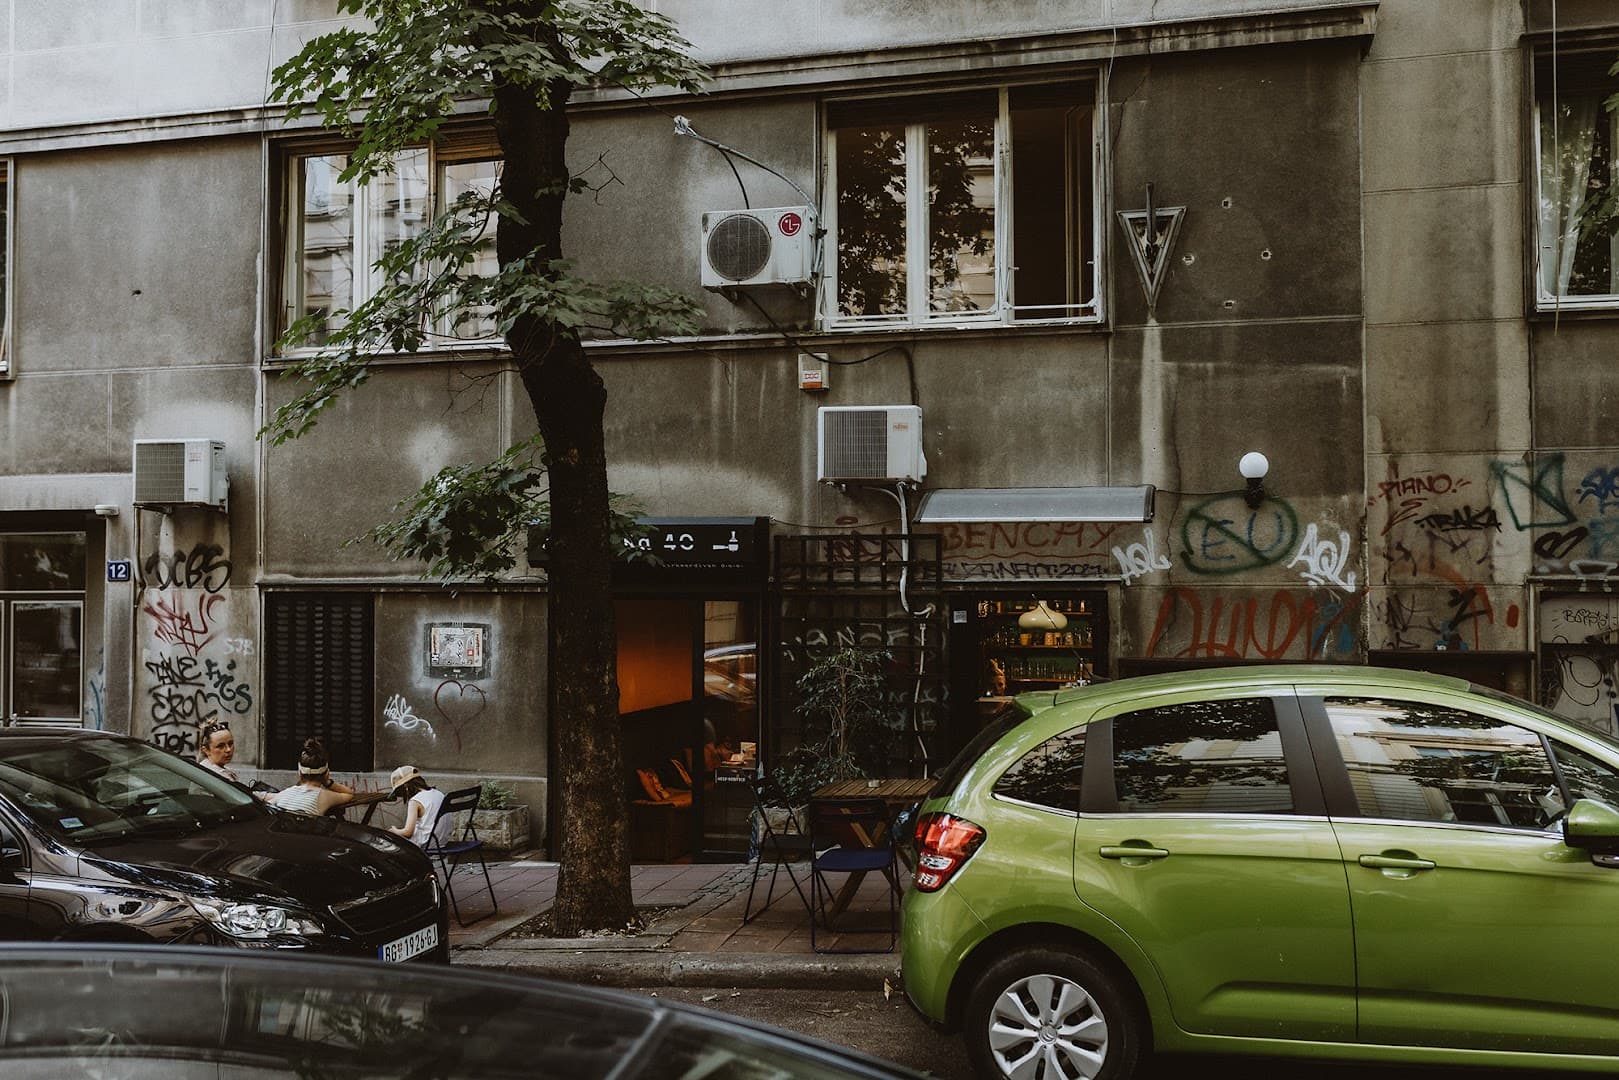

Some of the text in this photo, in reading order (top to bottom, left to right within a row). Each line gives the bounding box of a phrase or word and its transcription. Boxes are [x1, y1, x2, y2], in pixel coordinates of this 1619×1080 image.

[780, 213, 801, 236] LG
[109, 564, 126, 578] 12
[385, 944, 397, 962] BG
